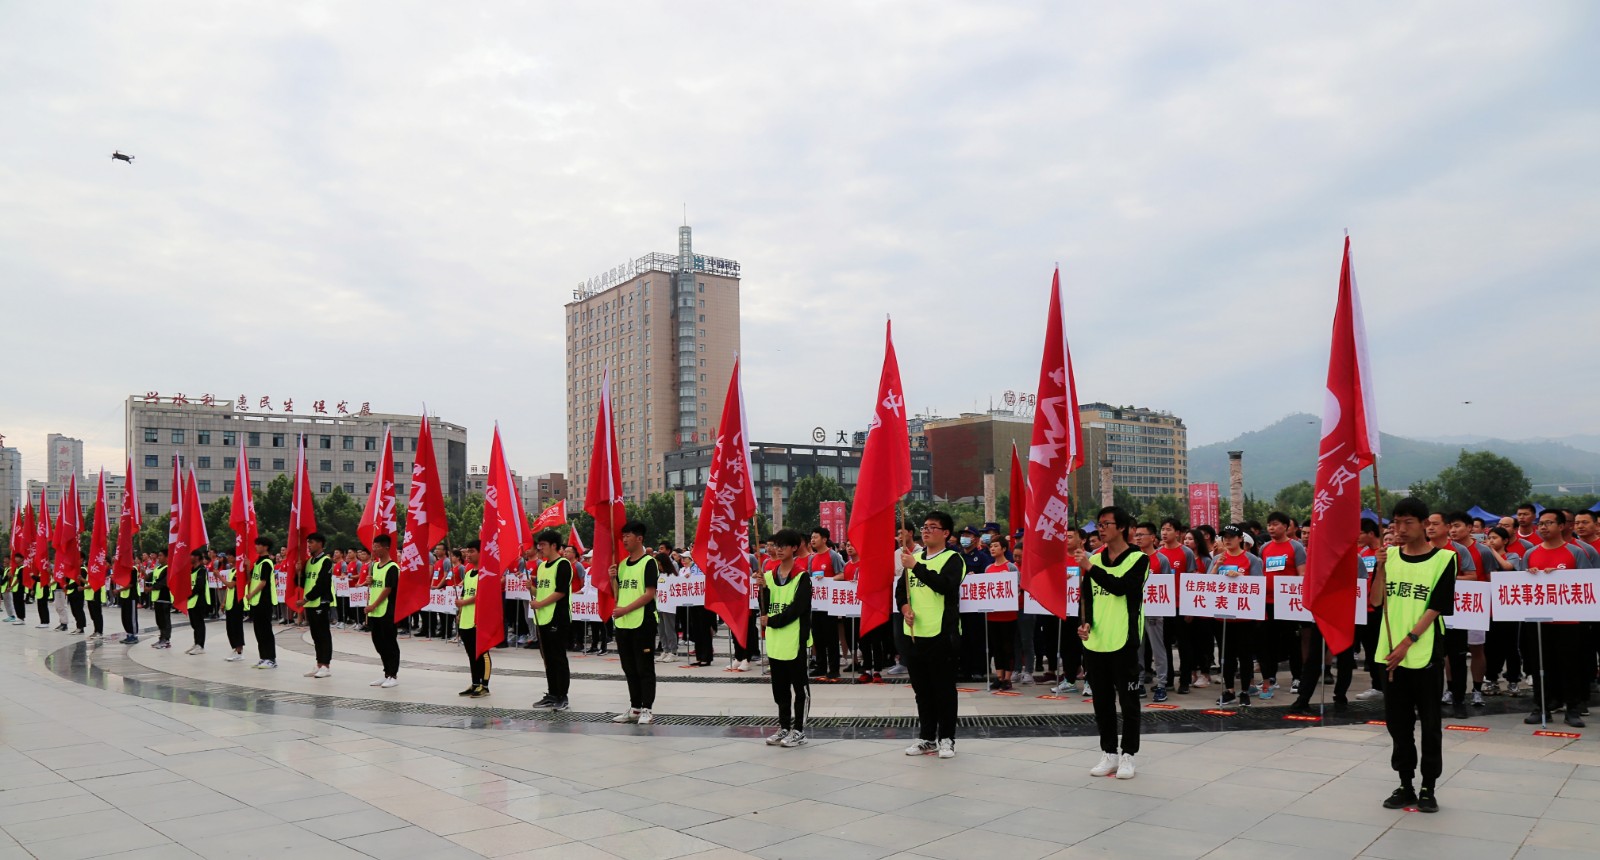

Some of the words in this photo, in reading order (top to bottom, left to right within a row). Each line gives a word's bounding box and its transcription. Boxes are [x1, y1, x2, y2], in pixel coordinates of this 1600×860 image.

[143, 391, 215, 407] 兴水利
[236, 394, 293, 412] 惠民生
[313, 400, 373, 416] 促发展
[961, 580, 1014, 600] 卫健委代表队
[1144, 584, 1170, 604] 表队
[1185, 580, 1260, 595] 住房城乡建设局
[1386, 581, 1430, 601] 志愿者
[1498, 582, 1597, 606] 机关事务局代表队
[1193, 595, 1251, 611] 代表队
